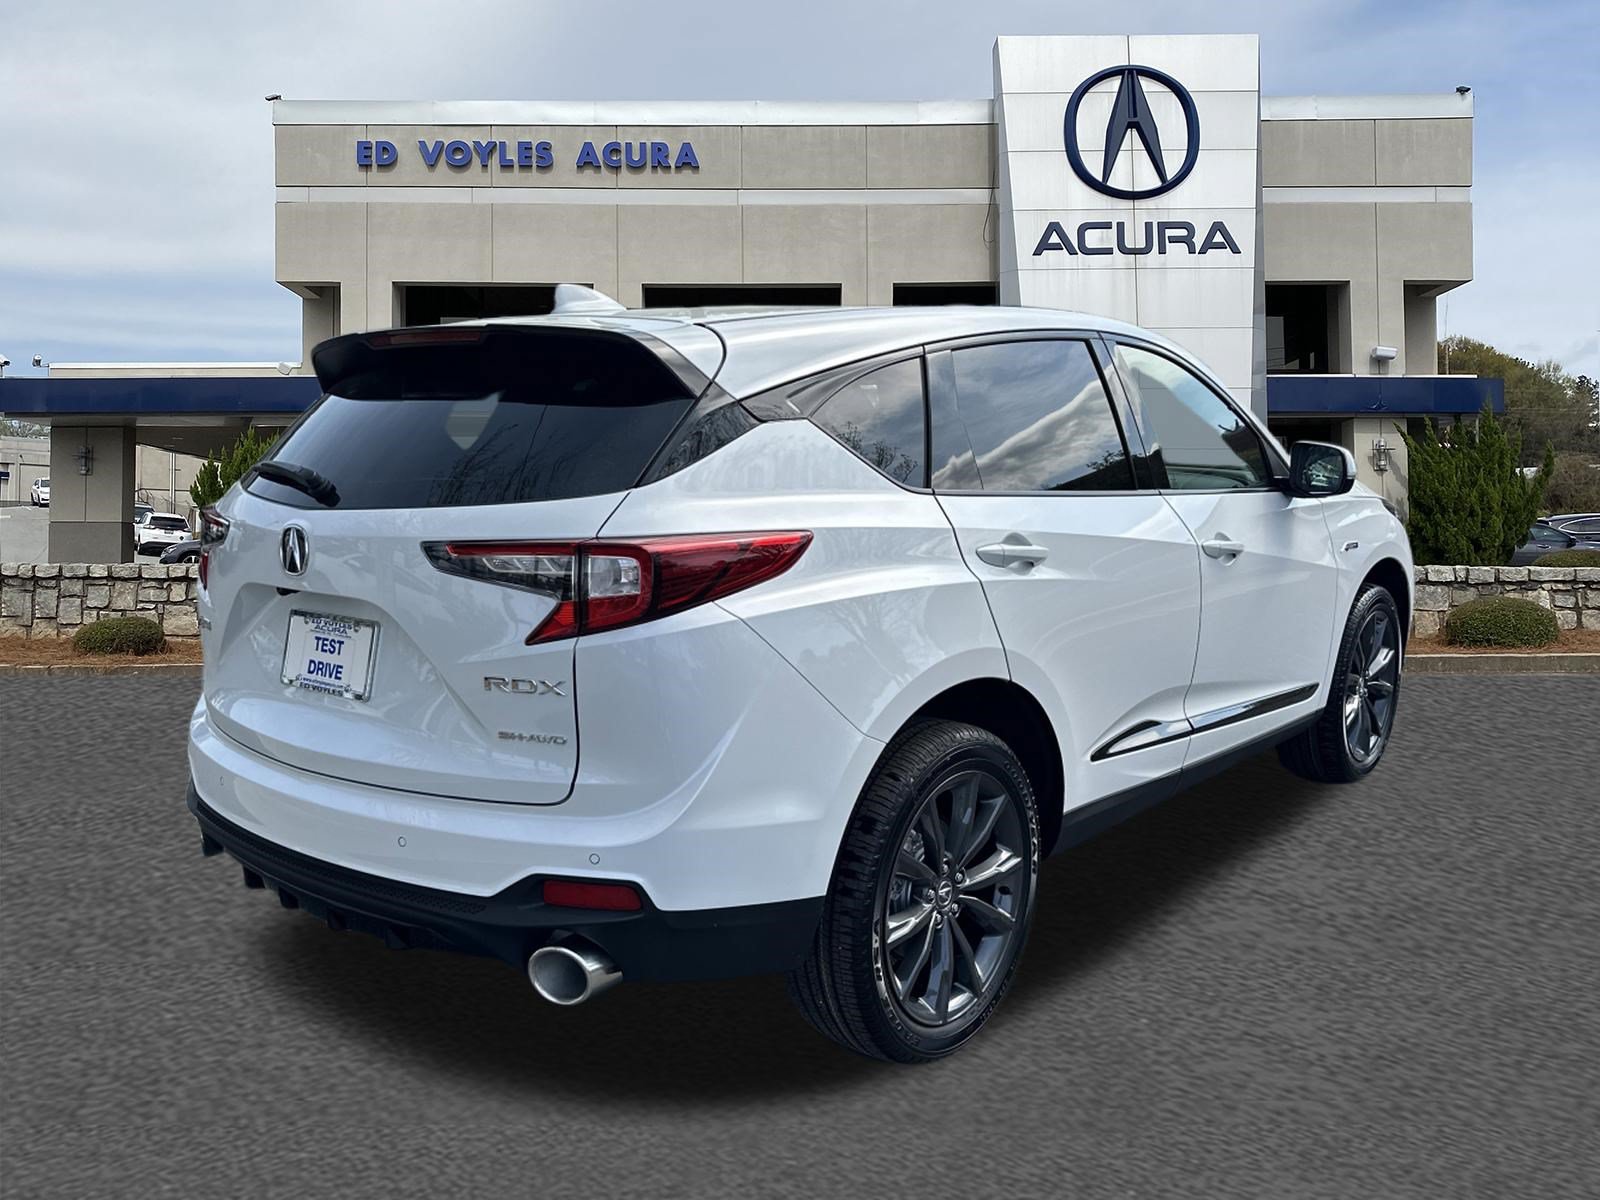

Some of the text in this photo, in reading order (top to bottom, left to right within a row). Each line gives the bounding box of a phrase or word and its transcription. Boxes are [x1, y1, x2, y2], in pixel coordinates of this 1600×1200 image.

[356, 140, 700, 169] ED VOYLES ACURA
[1032, 221, 1242, 256] ACURA
[314, 624, 348, 635] ACURA
[314, 635, 345, 656] TEST
[307, 659, 343, 681] DRIVE
[310, 684, 344, 697] VOYLES
[483, 676, 567, 697] RDX
